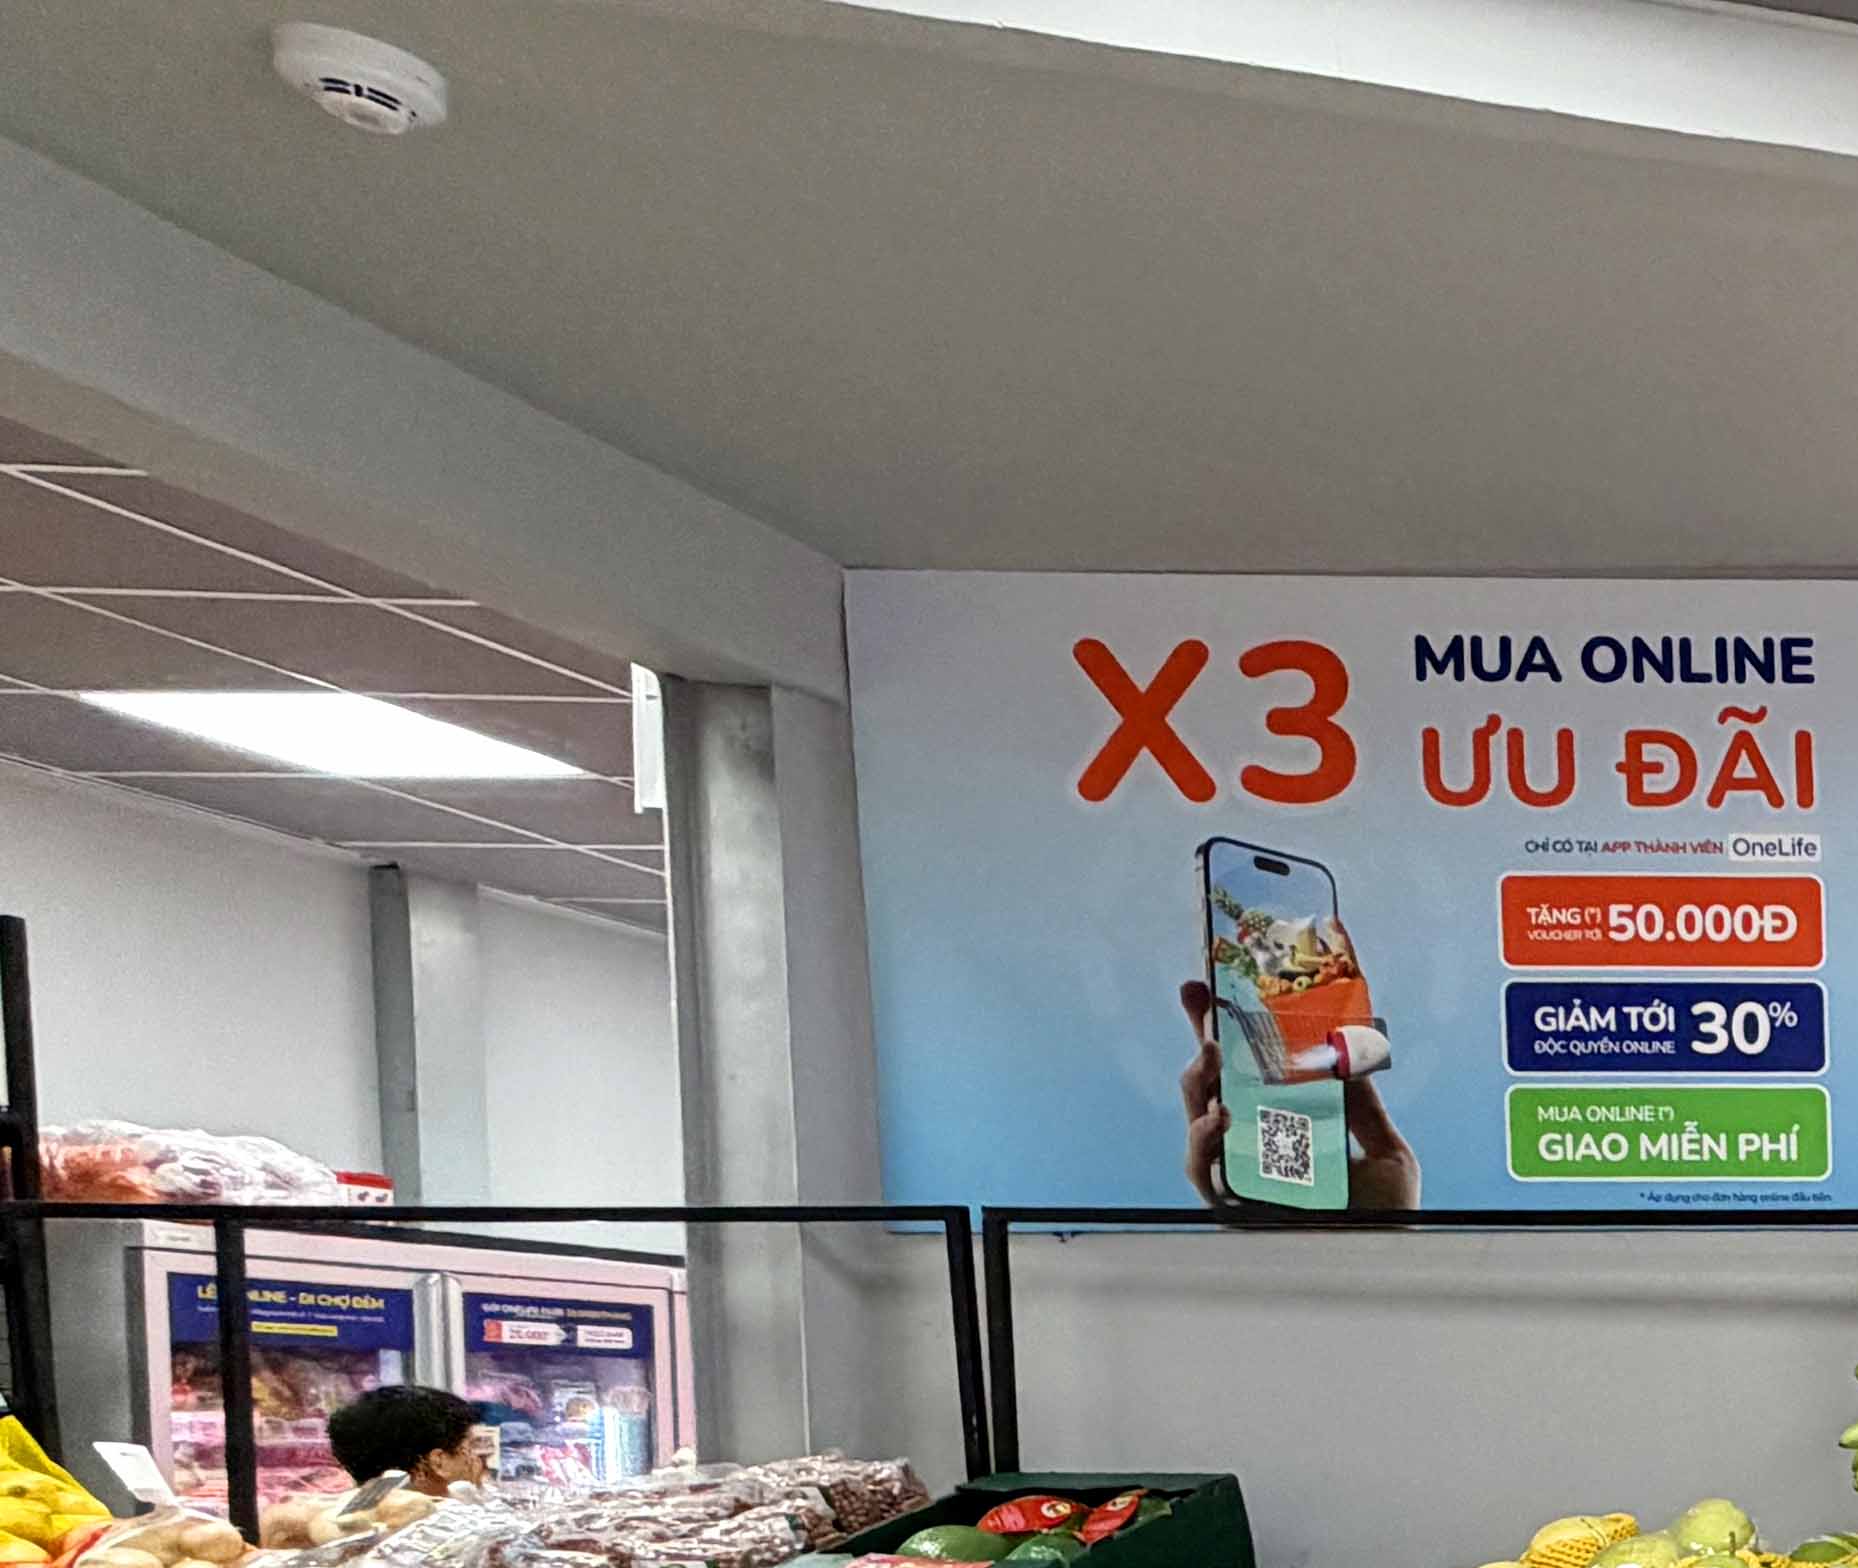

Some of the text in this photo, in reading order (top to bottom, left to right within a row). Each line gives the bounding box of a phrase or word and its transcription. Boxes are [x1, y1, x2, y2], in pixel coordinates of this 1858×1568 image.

[1415, 635, 1815, 685] MUA ONLINE
[1073, 634, 1357, 806] X3
[1421, 705, 1815, 810] ƯU ĐÃI
[1552, 838, 1574, 853] CÓ
[1602, 841, 1632, 853] APP
[1732, 838, 1817, 857] OneLife
[1609, 904, 1797, 942] 50.000Đ
[1535, 998, 1675, 1032] GIẢM TỚI
[1535, 1037, 1675, 1056] ĐỘC QUYỀN ONLINE
[1538, 1121, 1799, 1162] GIAO MIỄN PHÍ
